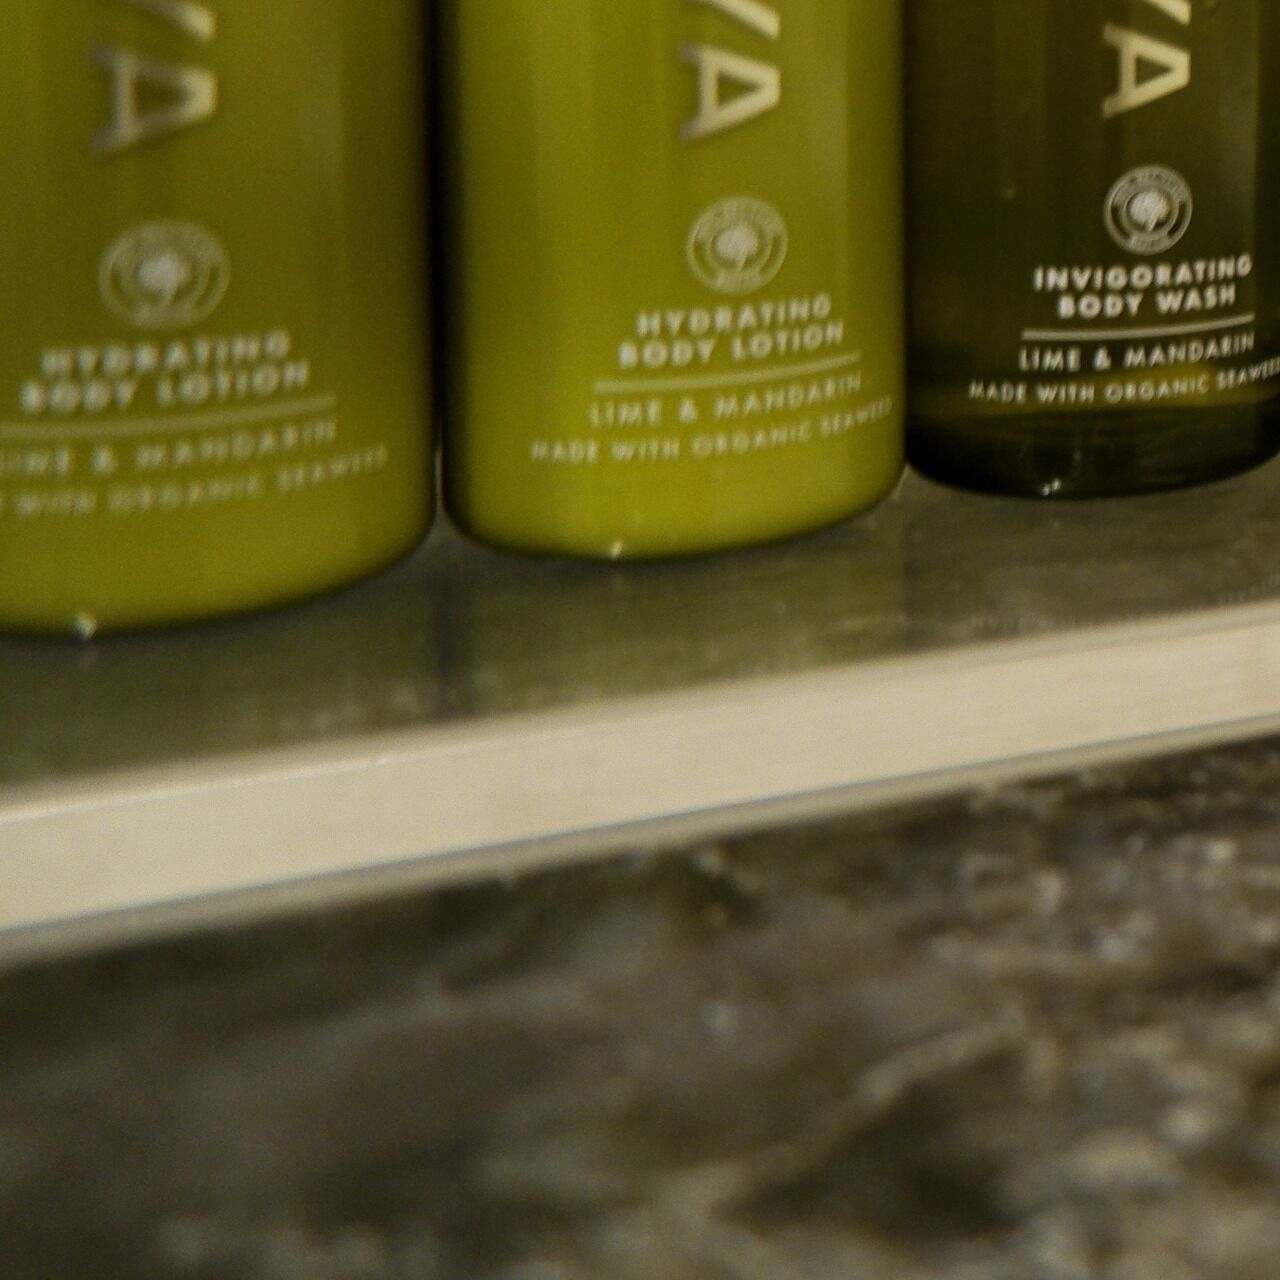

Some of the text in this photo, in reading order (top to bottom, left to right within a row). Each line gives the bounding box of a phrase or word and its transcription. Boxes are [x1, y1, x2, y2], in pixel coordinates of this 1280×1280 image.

[1033, 253, 1253, 292] INVIGORATING
[635, 292, 831, 338] HYDRATING
[1057, 282, 1237, 320] BODY WASH
[617, 318, 845, 370] BODY LOTION
[1018, 331, 1255, 372] LIME & MANDARIN
[968, 378, 1028, 405] MADE
[1036, 381, 1096, 405] WITH
[1104, 371, 1210, 404] ORGANIC
[589, 397, 662, 428] LIME
